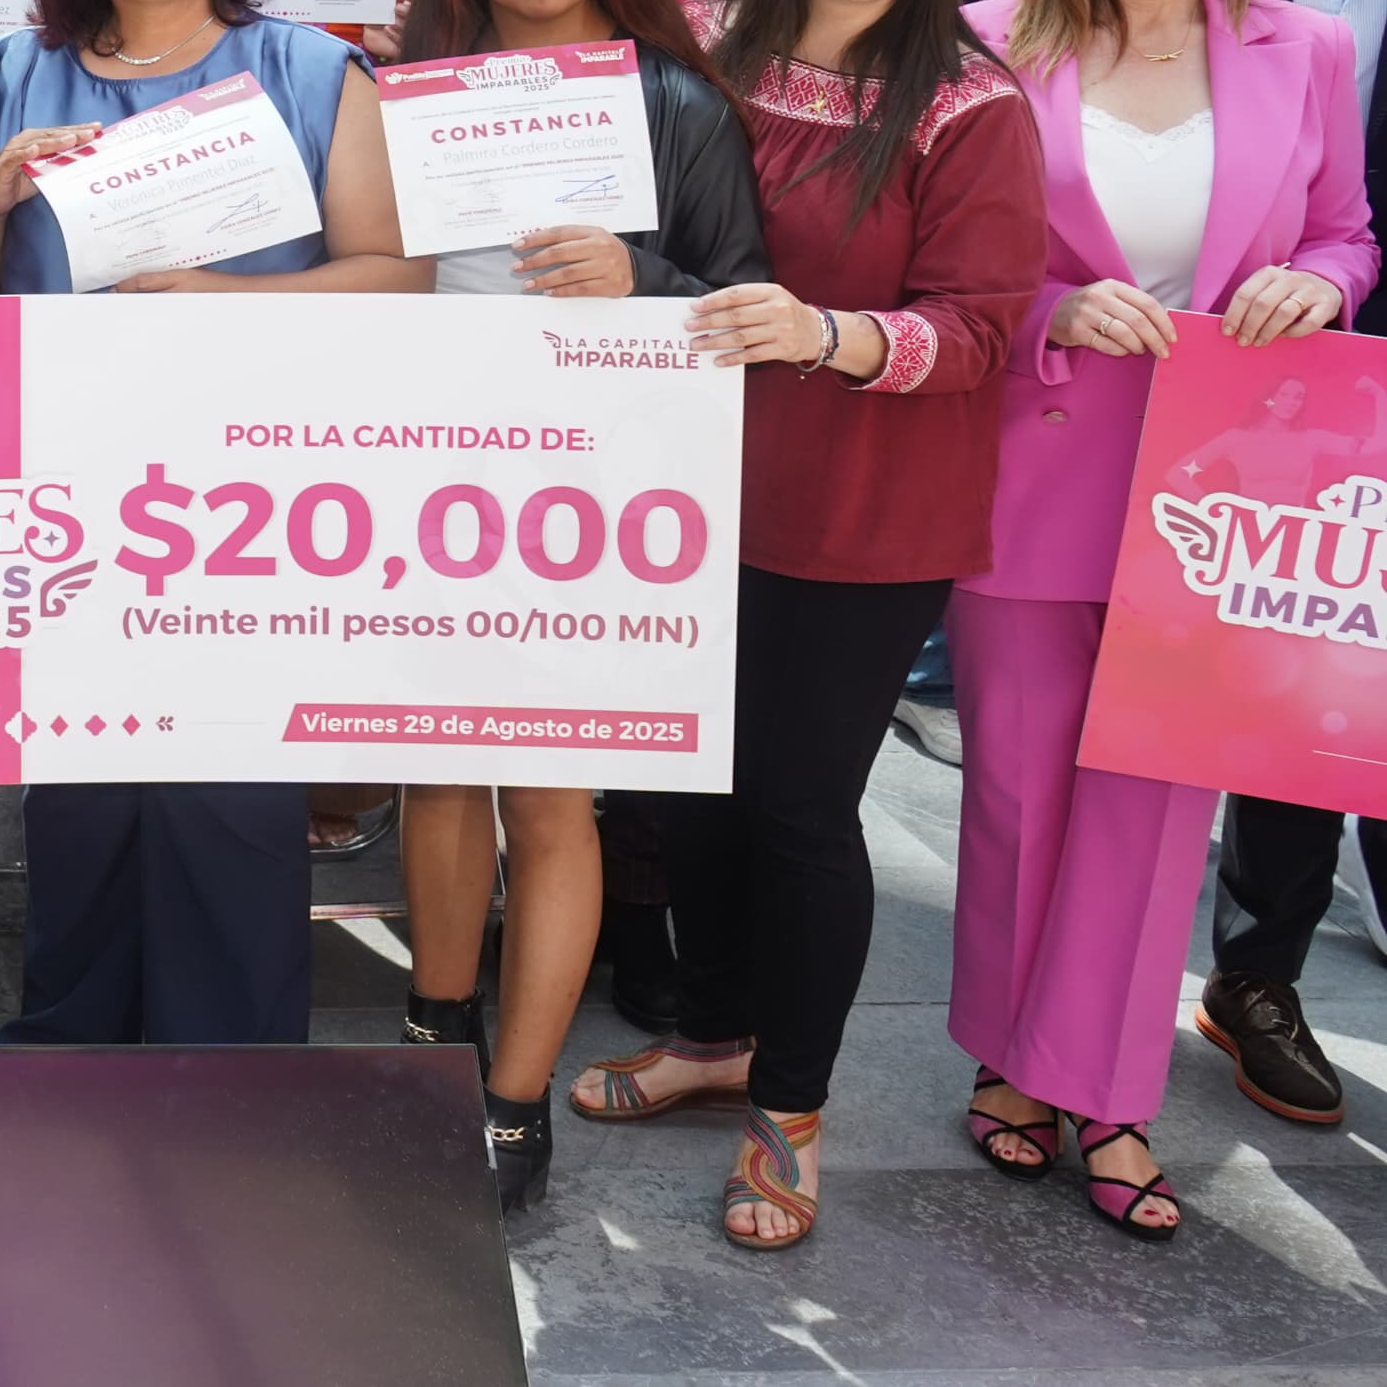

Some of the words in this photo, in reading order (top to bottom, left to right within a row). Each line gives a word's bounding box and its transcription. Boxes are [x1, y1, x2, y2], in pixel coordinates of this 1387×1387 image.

[468, 58, 558, 83] MUJERES
[476, 75, 549, 91] IMPARABLES
[524, 84, 550, 93] 2025
[431, 110, 613, 144] CONSTANCIA
[89, 130, 256, 195] CONSTANCIA
[501, 140, 560, 158] Cordero
[563, 134, 619, 151] Cordero
[555, 350, 700, 370] IMPARABLE
[564, 337, 589, 349] LA
[598, 337, 688, 350] CAPITAL
[225, 423, 294, 448] POR
[304, 424, 345, 448] LA
[353, 424, 531, 451] CANTIDAD
[539, 427, 596, 452] DE:
[1350, 484, 1387, 522] P
[114, 463, 708, 596] $20,000
[1195, 502, 1387, 592] MU
[1228, 582, 1387, 639] IMPA
[121, 606, 259, 640] (Veinte
[269, 606, 331, 635] mil
[343, 611, 456, 642] pesos
[465, 609, 607, 643] 00/100
[618, 615, 701, 649] MN)
[301, 711, 399, 735] Viernes
[403, 713, 436, 735] 29
[440, 713, 475, 736] de
[480, 715, 573, 744] Agosto
[577, 717, 614, 740] de
[618, 719, 685, 742] 2025
